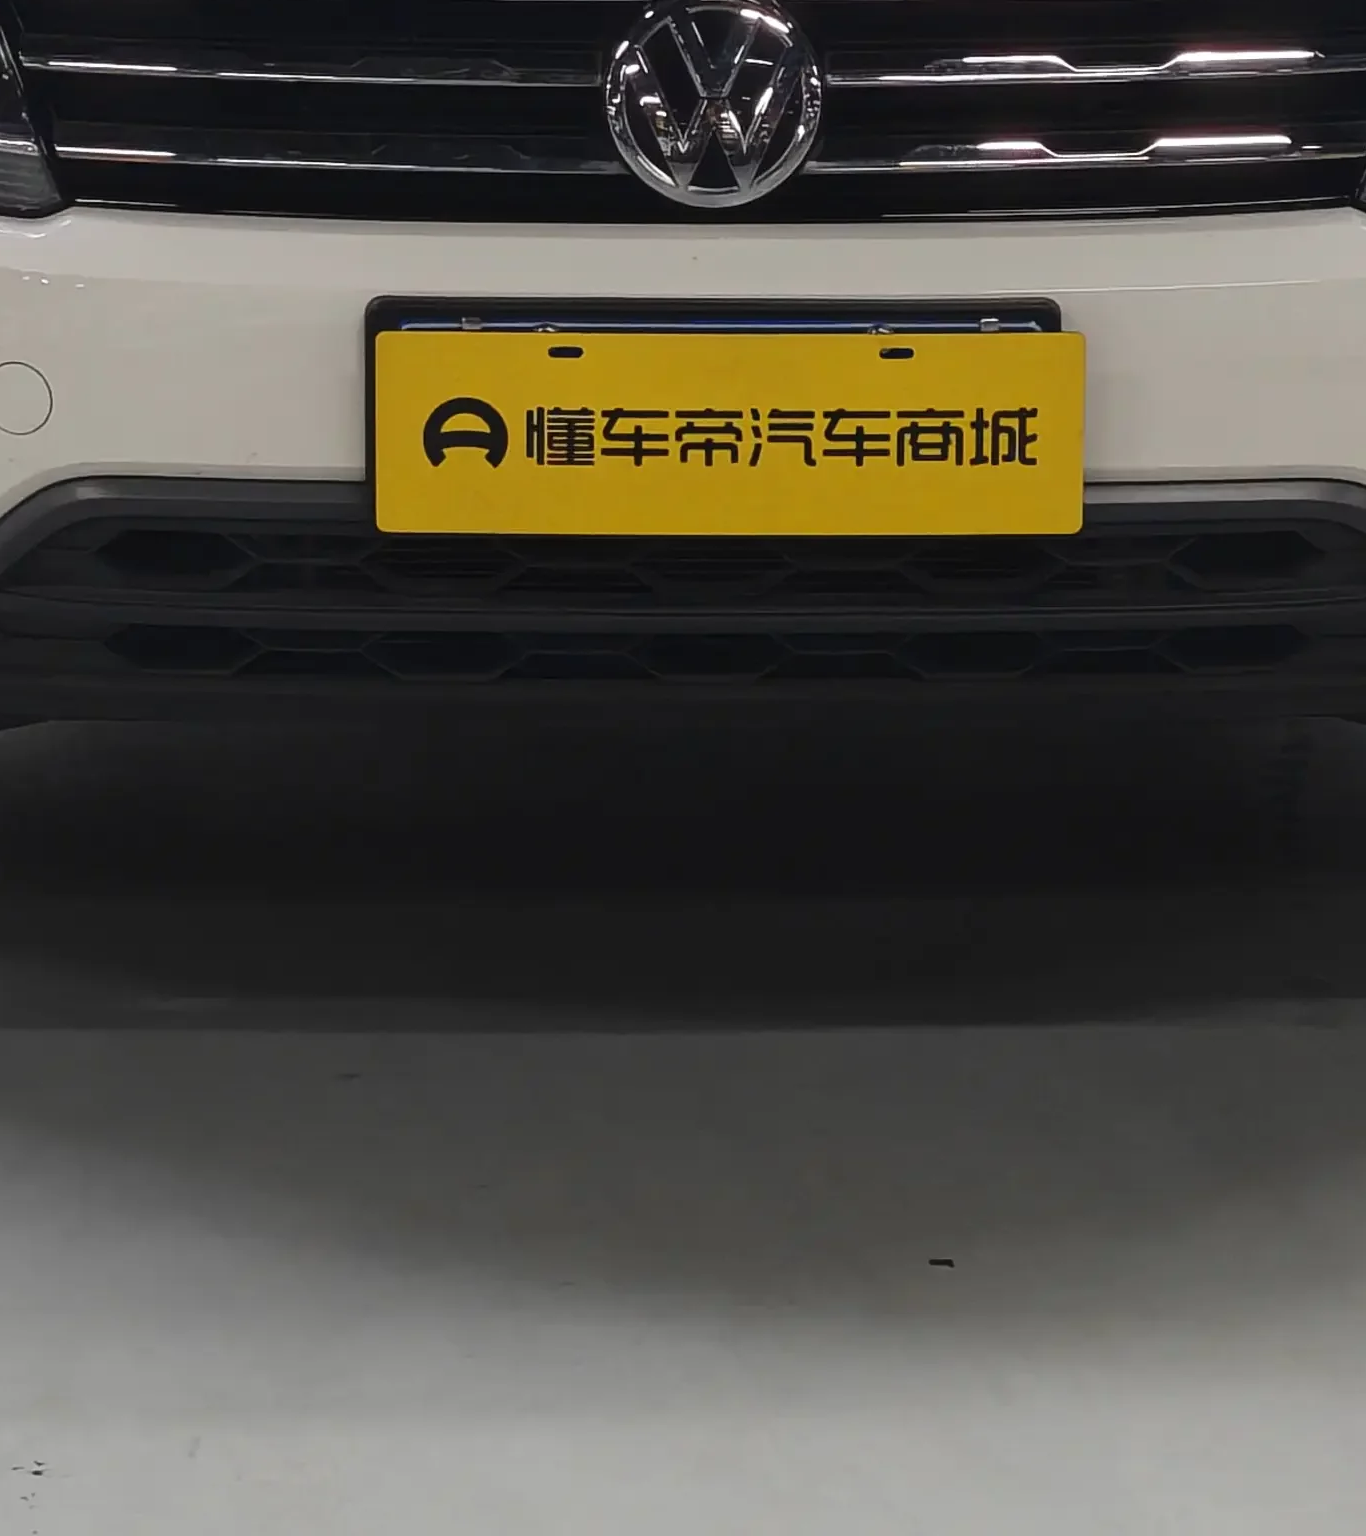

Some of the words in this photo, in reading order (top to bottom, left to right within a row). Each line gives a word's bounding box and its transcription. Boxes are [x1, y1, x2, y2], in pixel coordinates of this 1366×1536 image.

[525, 406, 1039, 467] 懂车帝汽车商城
